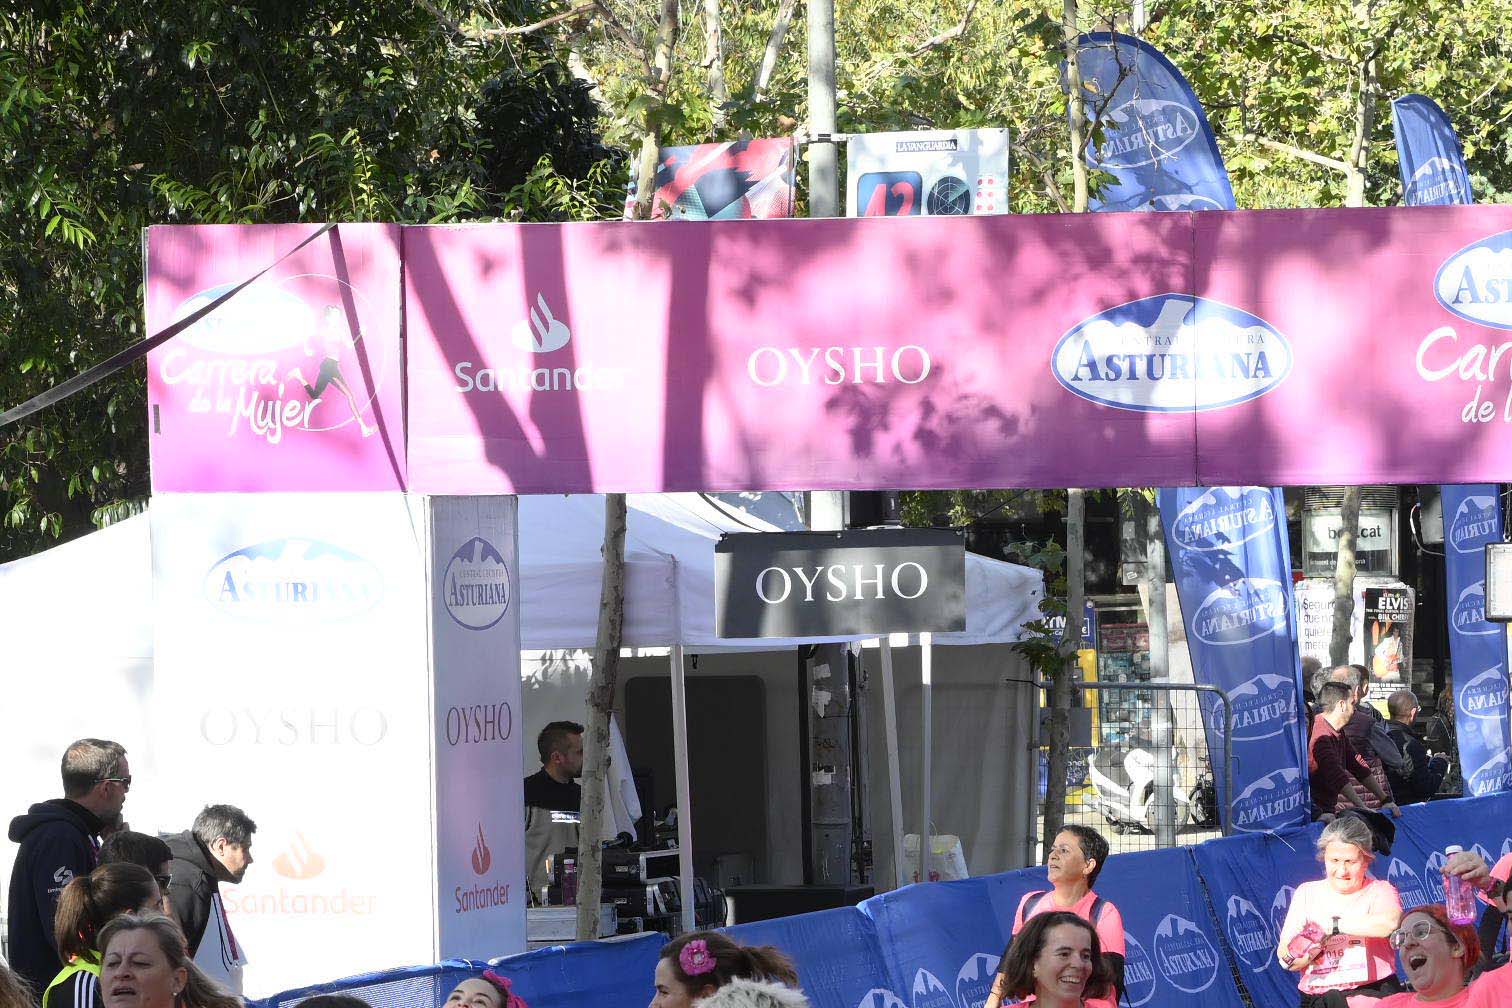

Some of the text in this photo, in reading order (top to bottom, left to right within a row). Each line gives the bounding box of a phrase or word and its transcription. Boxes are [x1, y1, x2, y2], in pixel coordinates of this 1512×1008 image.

[747, 344, 932, 388] OYSHO
[1071, 339, 1273, 382] ASTURIANA
[1461, 384, 1496, 424] de
[449, 571, 507, 607] ASTURIANA
[755, 562, 928, 605] OYSHO
[446, 701, 512, 746] OYSHO
[454, 882, 510, 914] Santander
